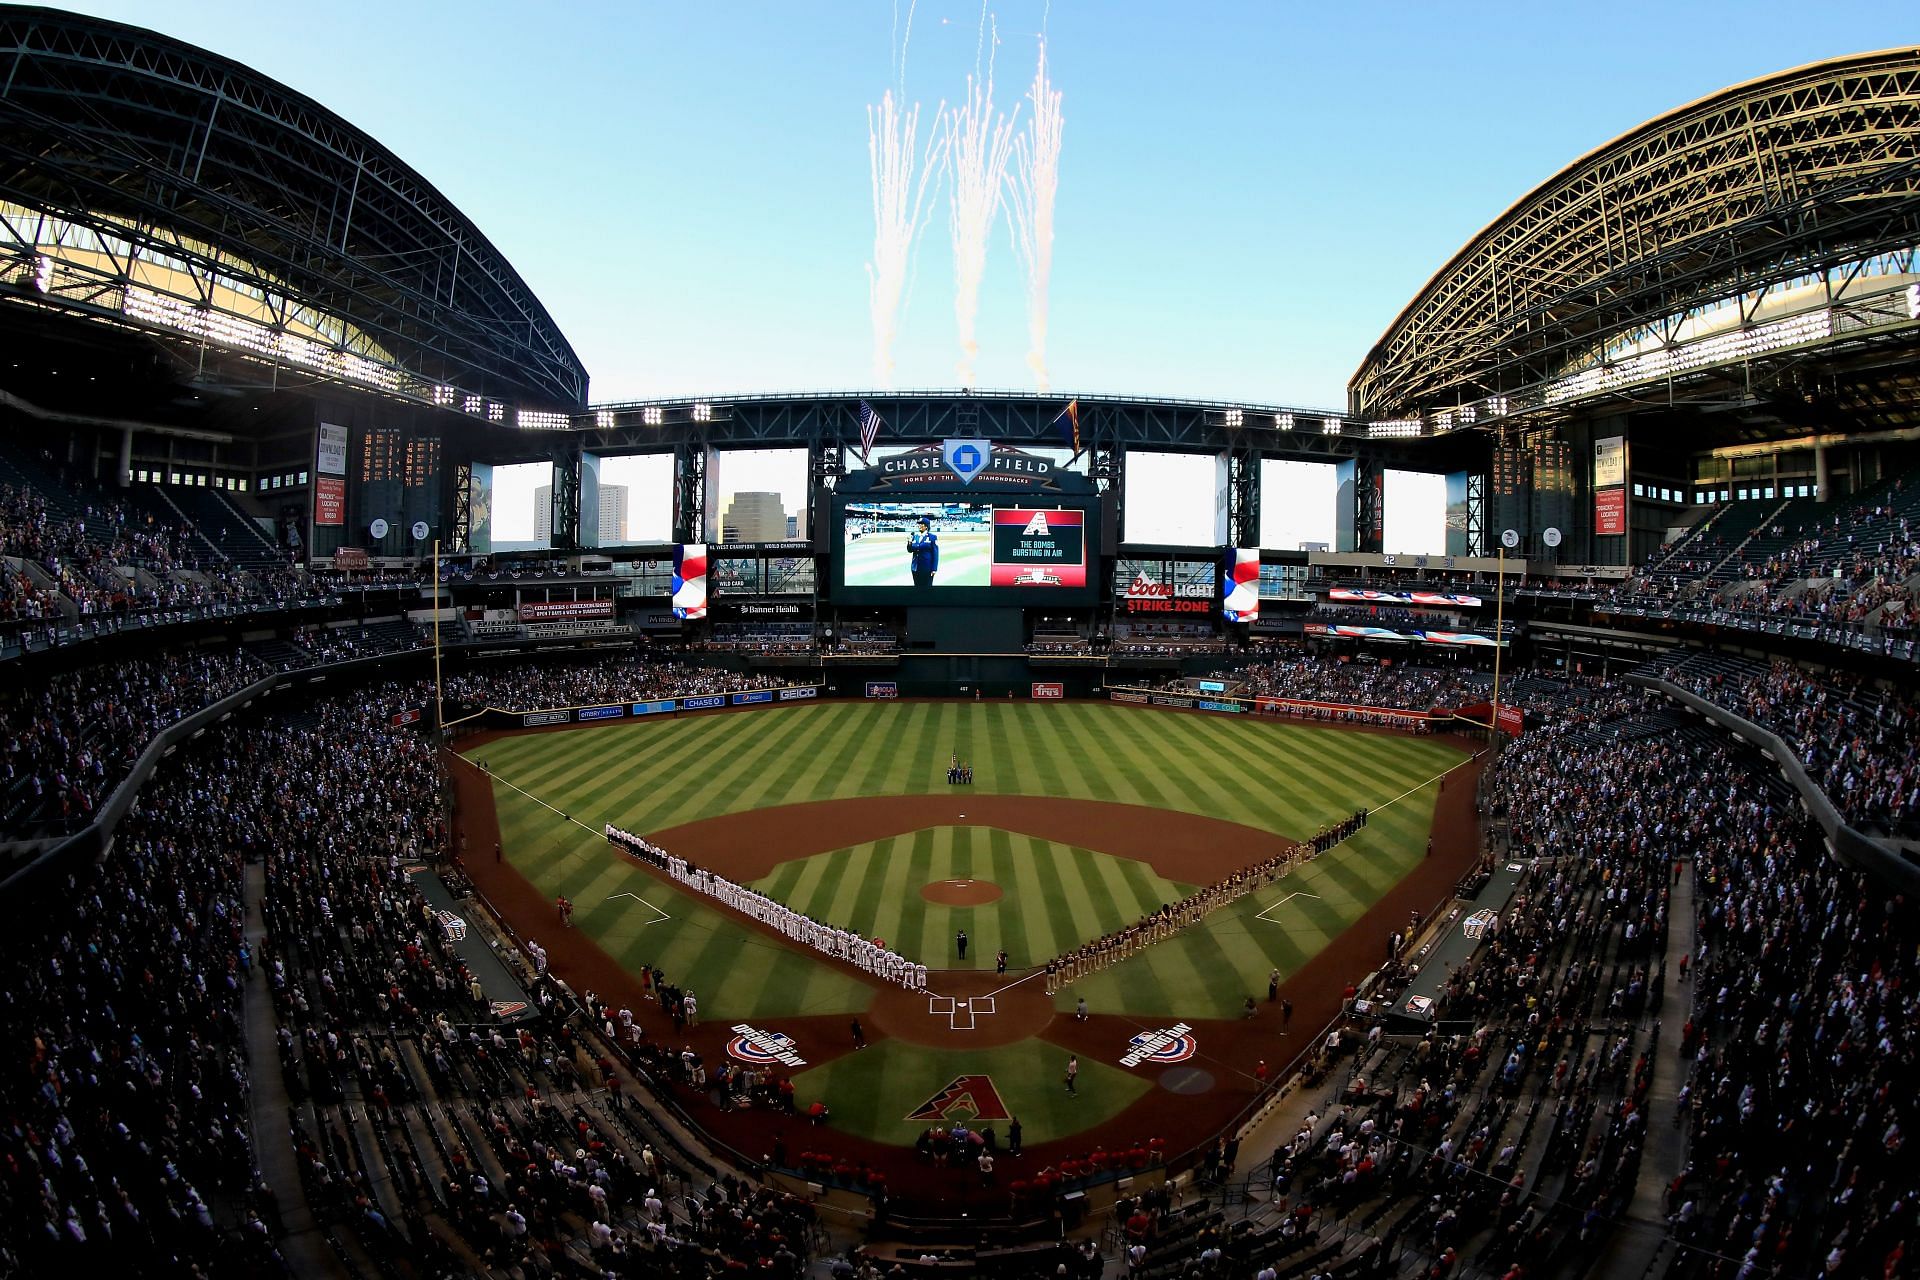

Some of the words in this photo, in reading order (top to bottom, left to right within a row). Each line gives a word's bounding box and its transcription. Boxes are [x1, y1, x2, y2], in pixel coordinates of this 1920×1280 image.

[884, 457, 940, 472] CHASE
[994, 457, 1048, 473] FIELD
[978, 475, 1028, 484] DIAMONDBACKS
[1020, 540, 1032, 548] THE
[1033, 541, 1055, 549] BOMBS
[1012, 548, 1043, 557] BURSTING
[1043, 549, 1050, 557] IN
[1051, 549, 1063, 557] AIR
[1383, 555, 1395, 565] 42
[1128, 577, 1174, 596] Coors
[1174, 584, 1215, 598] LIGHT
[749, 605, 776, 614] Banner
[775, 605, 799, 613] Health
[1127, 600, 1172, 611] STRIKE
[1174, 601, 1210, 612] ZONE
[781, 687, 816, 699] GEICO
[688, 698, 712, 707] CHASE
[730, 1023, 785, 1054] OPENING
[773, 1051, 808, 1067] DAY
[1119, 1034, 1175, 1067] OPENING
[1164, 1022, 1193, 1039] DAY
